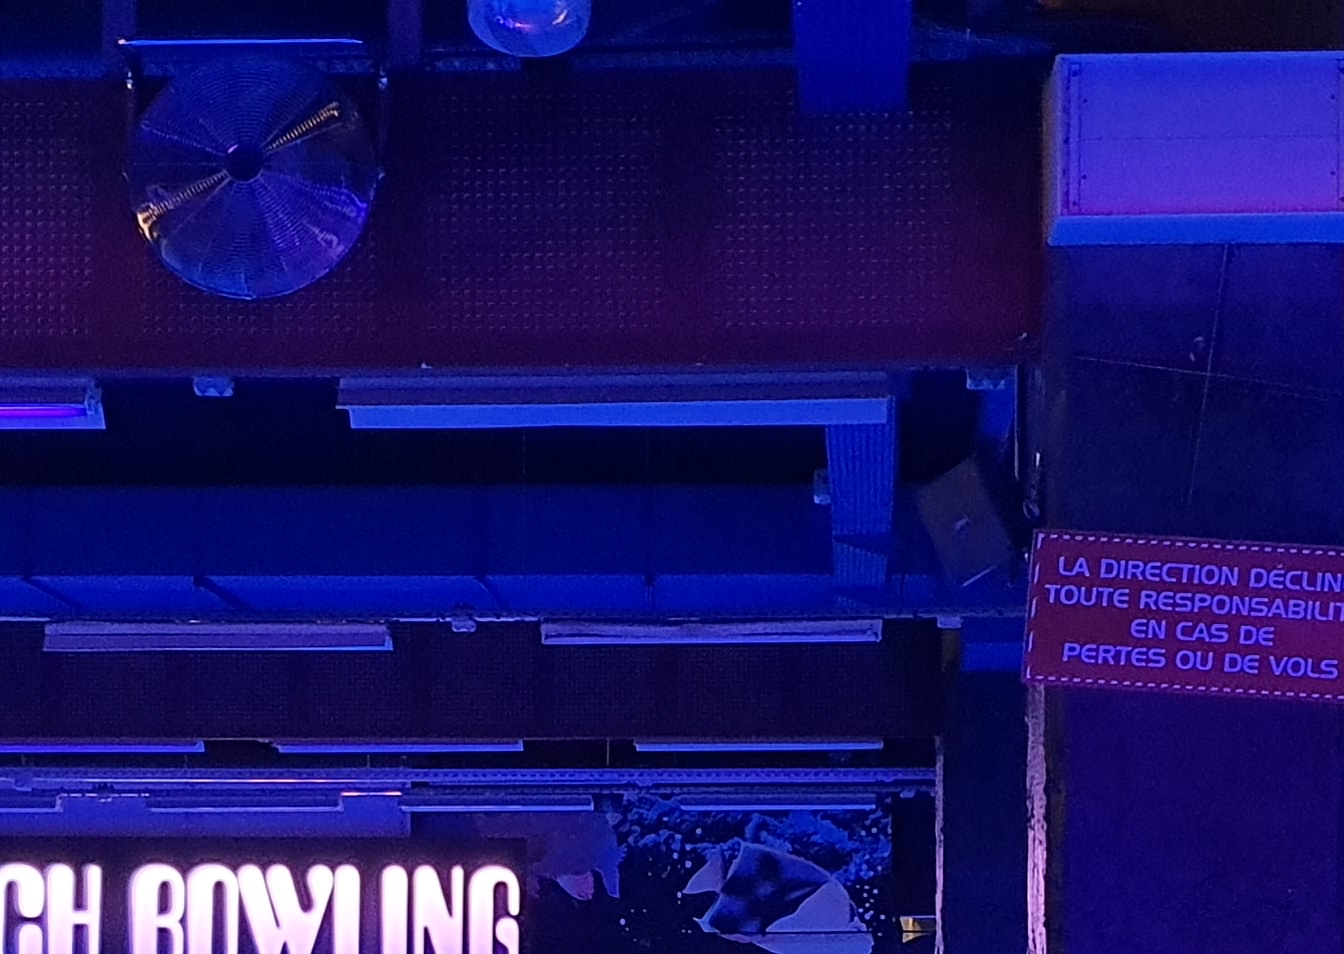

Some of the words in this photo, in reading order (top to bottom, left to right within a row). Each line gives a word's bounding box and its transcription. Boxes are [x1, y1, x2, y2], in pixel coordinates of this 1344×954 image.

[1058, 556, 1090, 577] LA
[1099, 558, 1239, 586] DIRECTION
[1044, 584, 1130, 608] TOUTE
[1130, 618, 1166, 639] EN
[1175, 621, 1229, 643] CAS
[1239, 625, 1275, 646] DE
[1062, 642, 1166, 669] PERTES
[1175, 650, 1214, 671] OU
[1224, 652, 1259, 674] DE
[1269, 655, 1339, 680] VOLS
